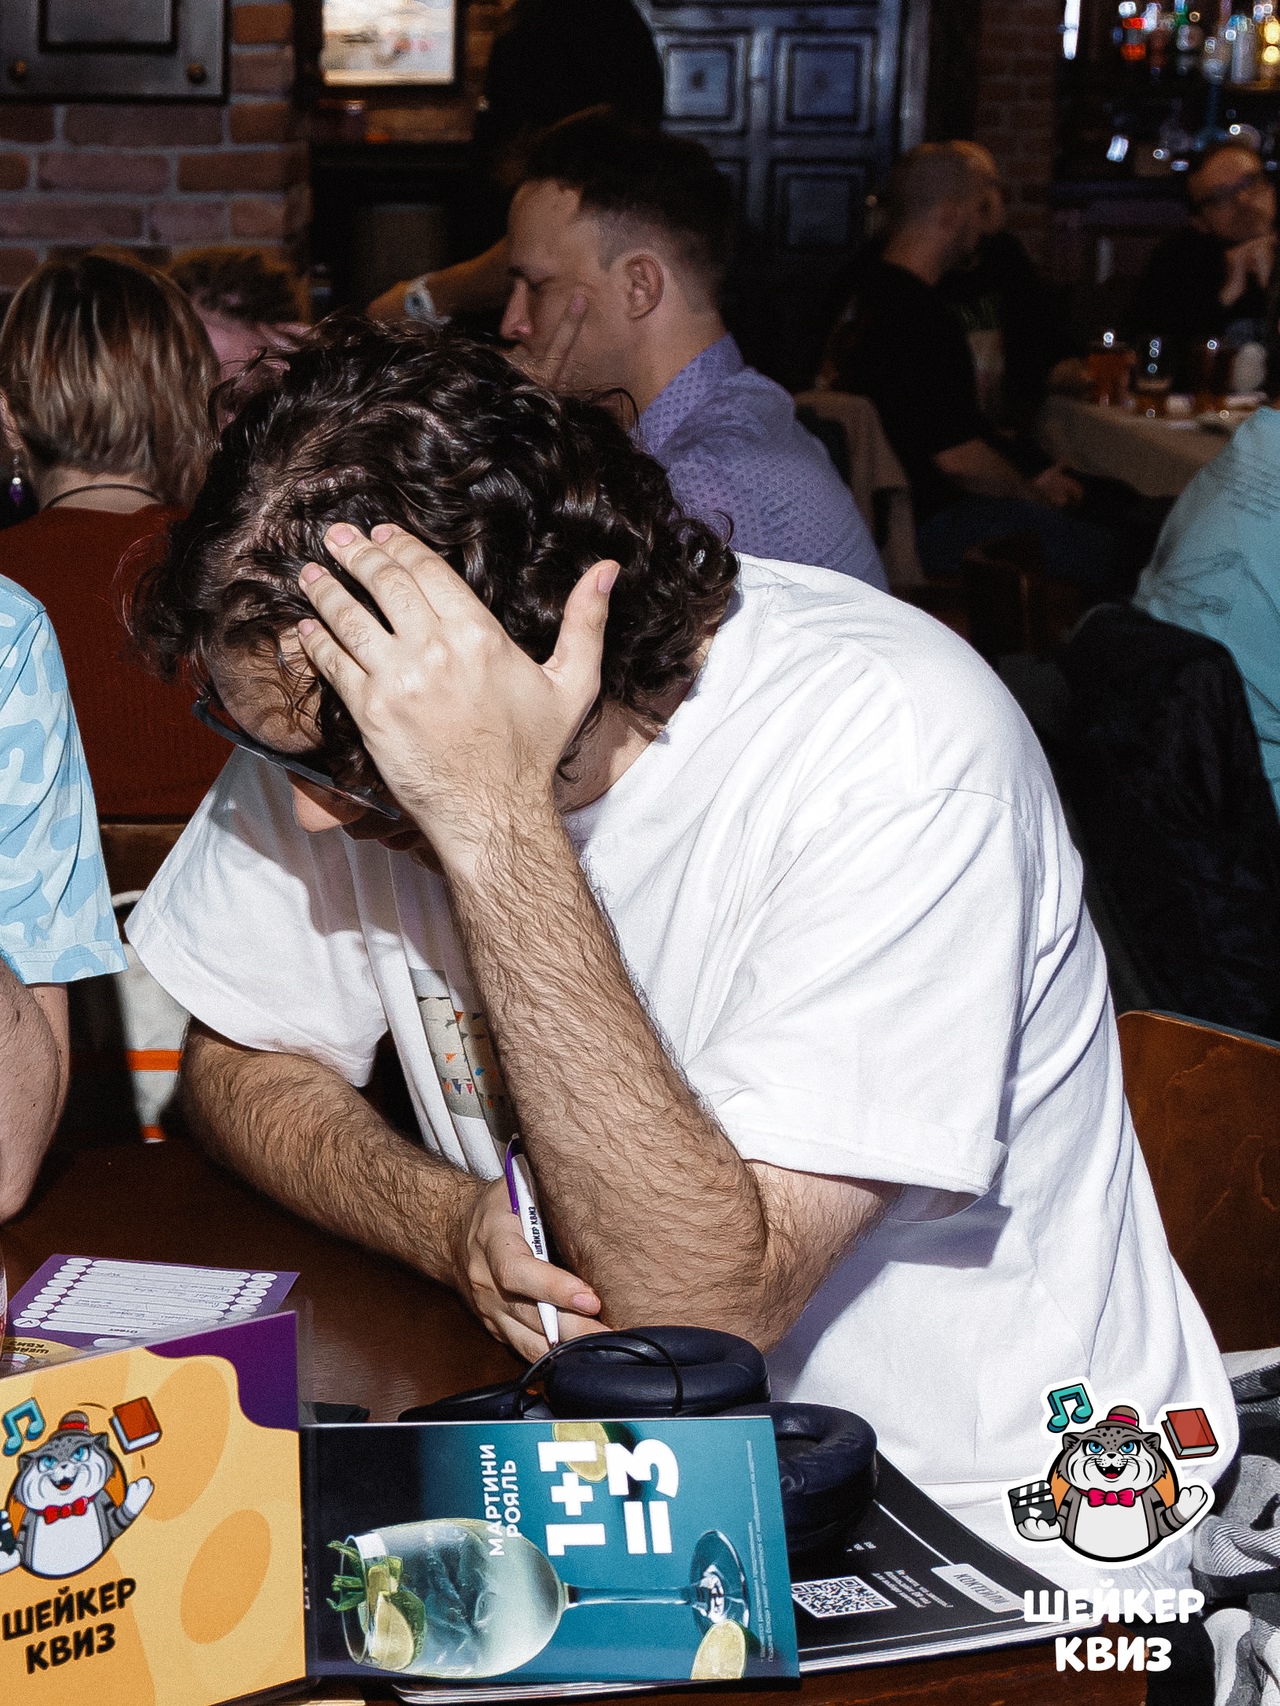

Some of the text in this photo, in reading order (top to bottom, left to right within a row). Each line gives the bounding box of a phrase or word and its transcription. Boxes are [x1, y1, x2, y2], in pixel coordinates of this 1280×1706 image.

[528, 1206, 543, 1255] ШЕЙКЕР КВИЗ
[479, 1444, 505, 1557] МАРТИНИ
[500, 1460, 522, 1538] РОЯЛЬ
[537, 1440, 606, 1556] 1+1
[604, 1438, 680, 1555] =3
[2, 1576, 137, 1641] ШЕЙКЕР
[25, 1622, 116, 1675] КВИЗ
